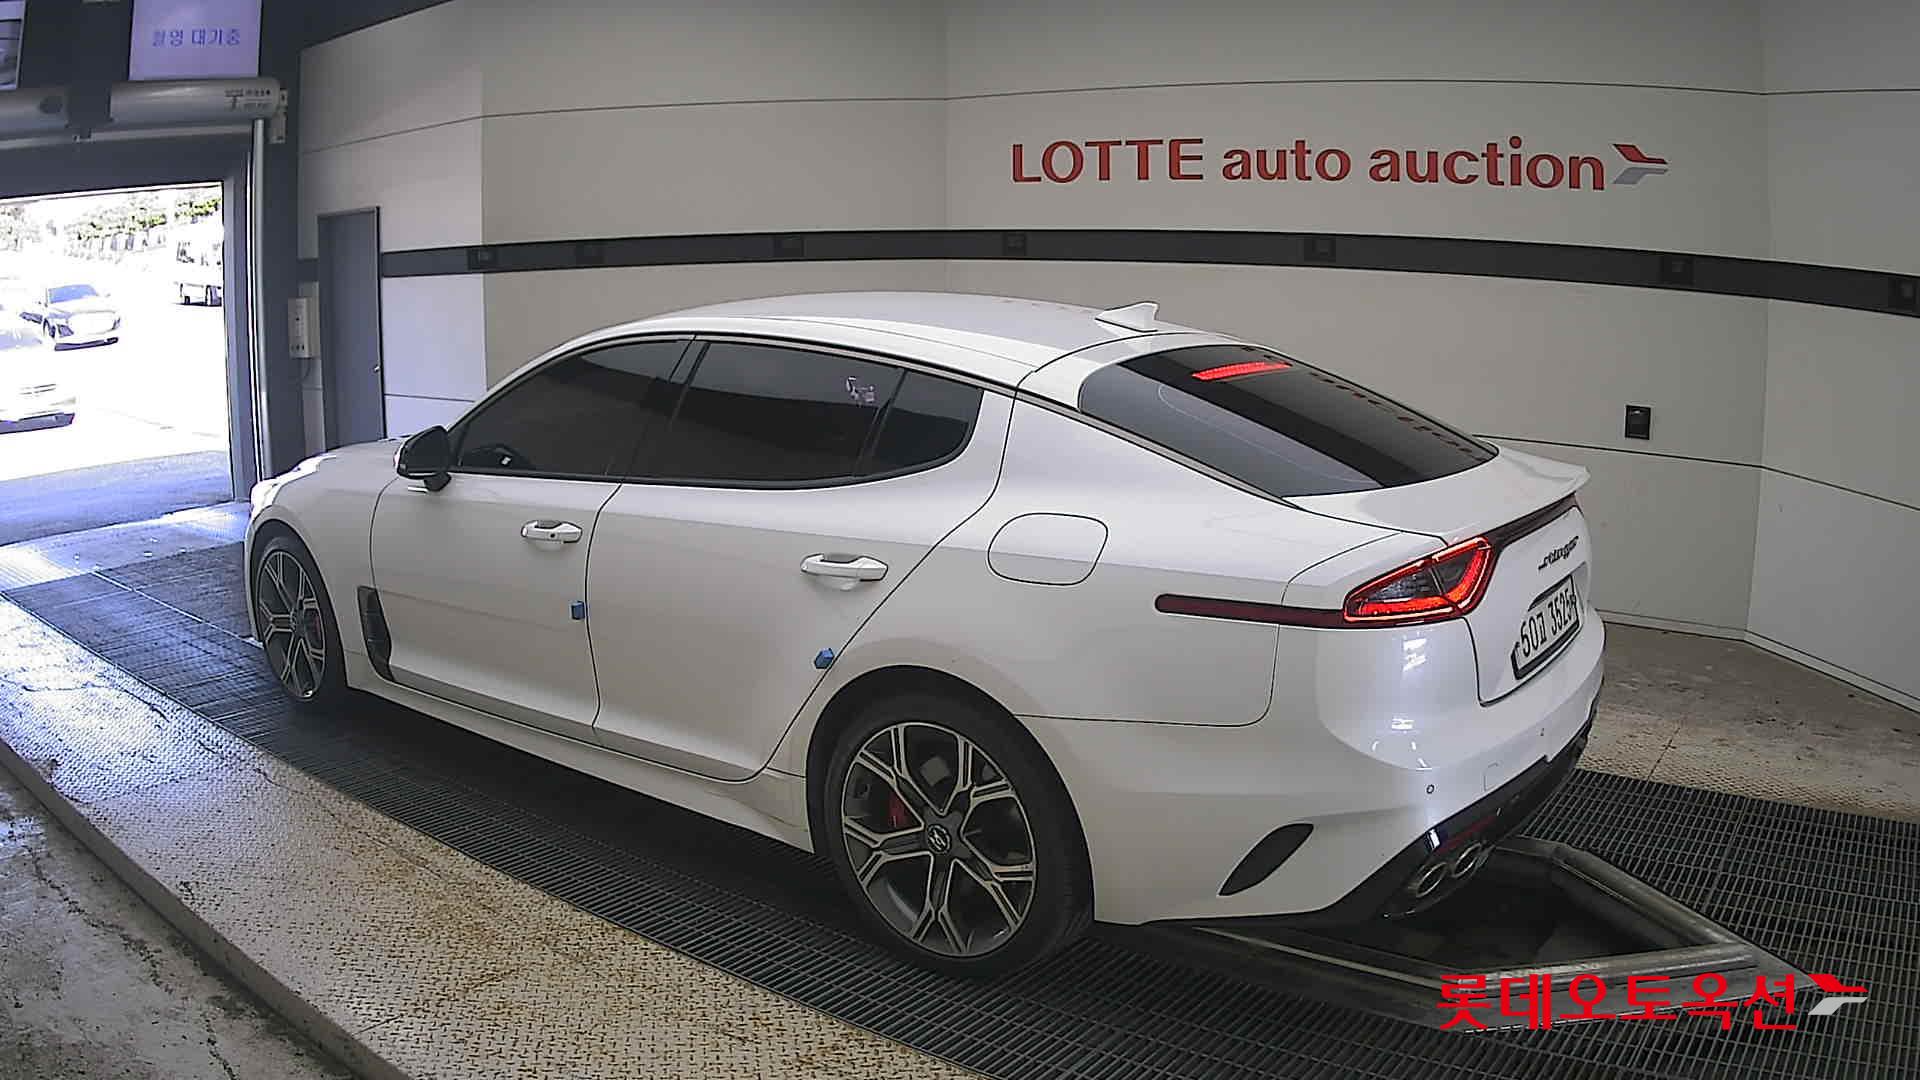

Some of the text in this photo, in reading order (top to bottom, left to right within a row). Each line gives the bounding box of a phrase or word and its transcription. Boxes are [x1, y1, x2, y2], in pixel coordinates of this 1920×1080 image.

[191, 29, 241, 46] 대기중
[1012, 137, 1605, 190] LOTTE auto auction
[1547, 587, 1574, 636] 3525
